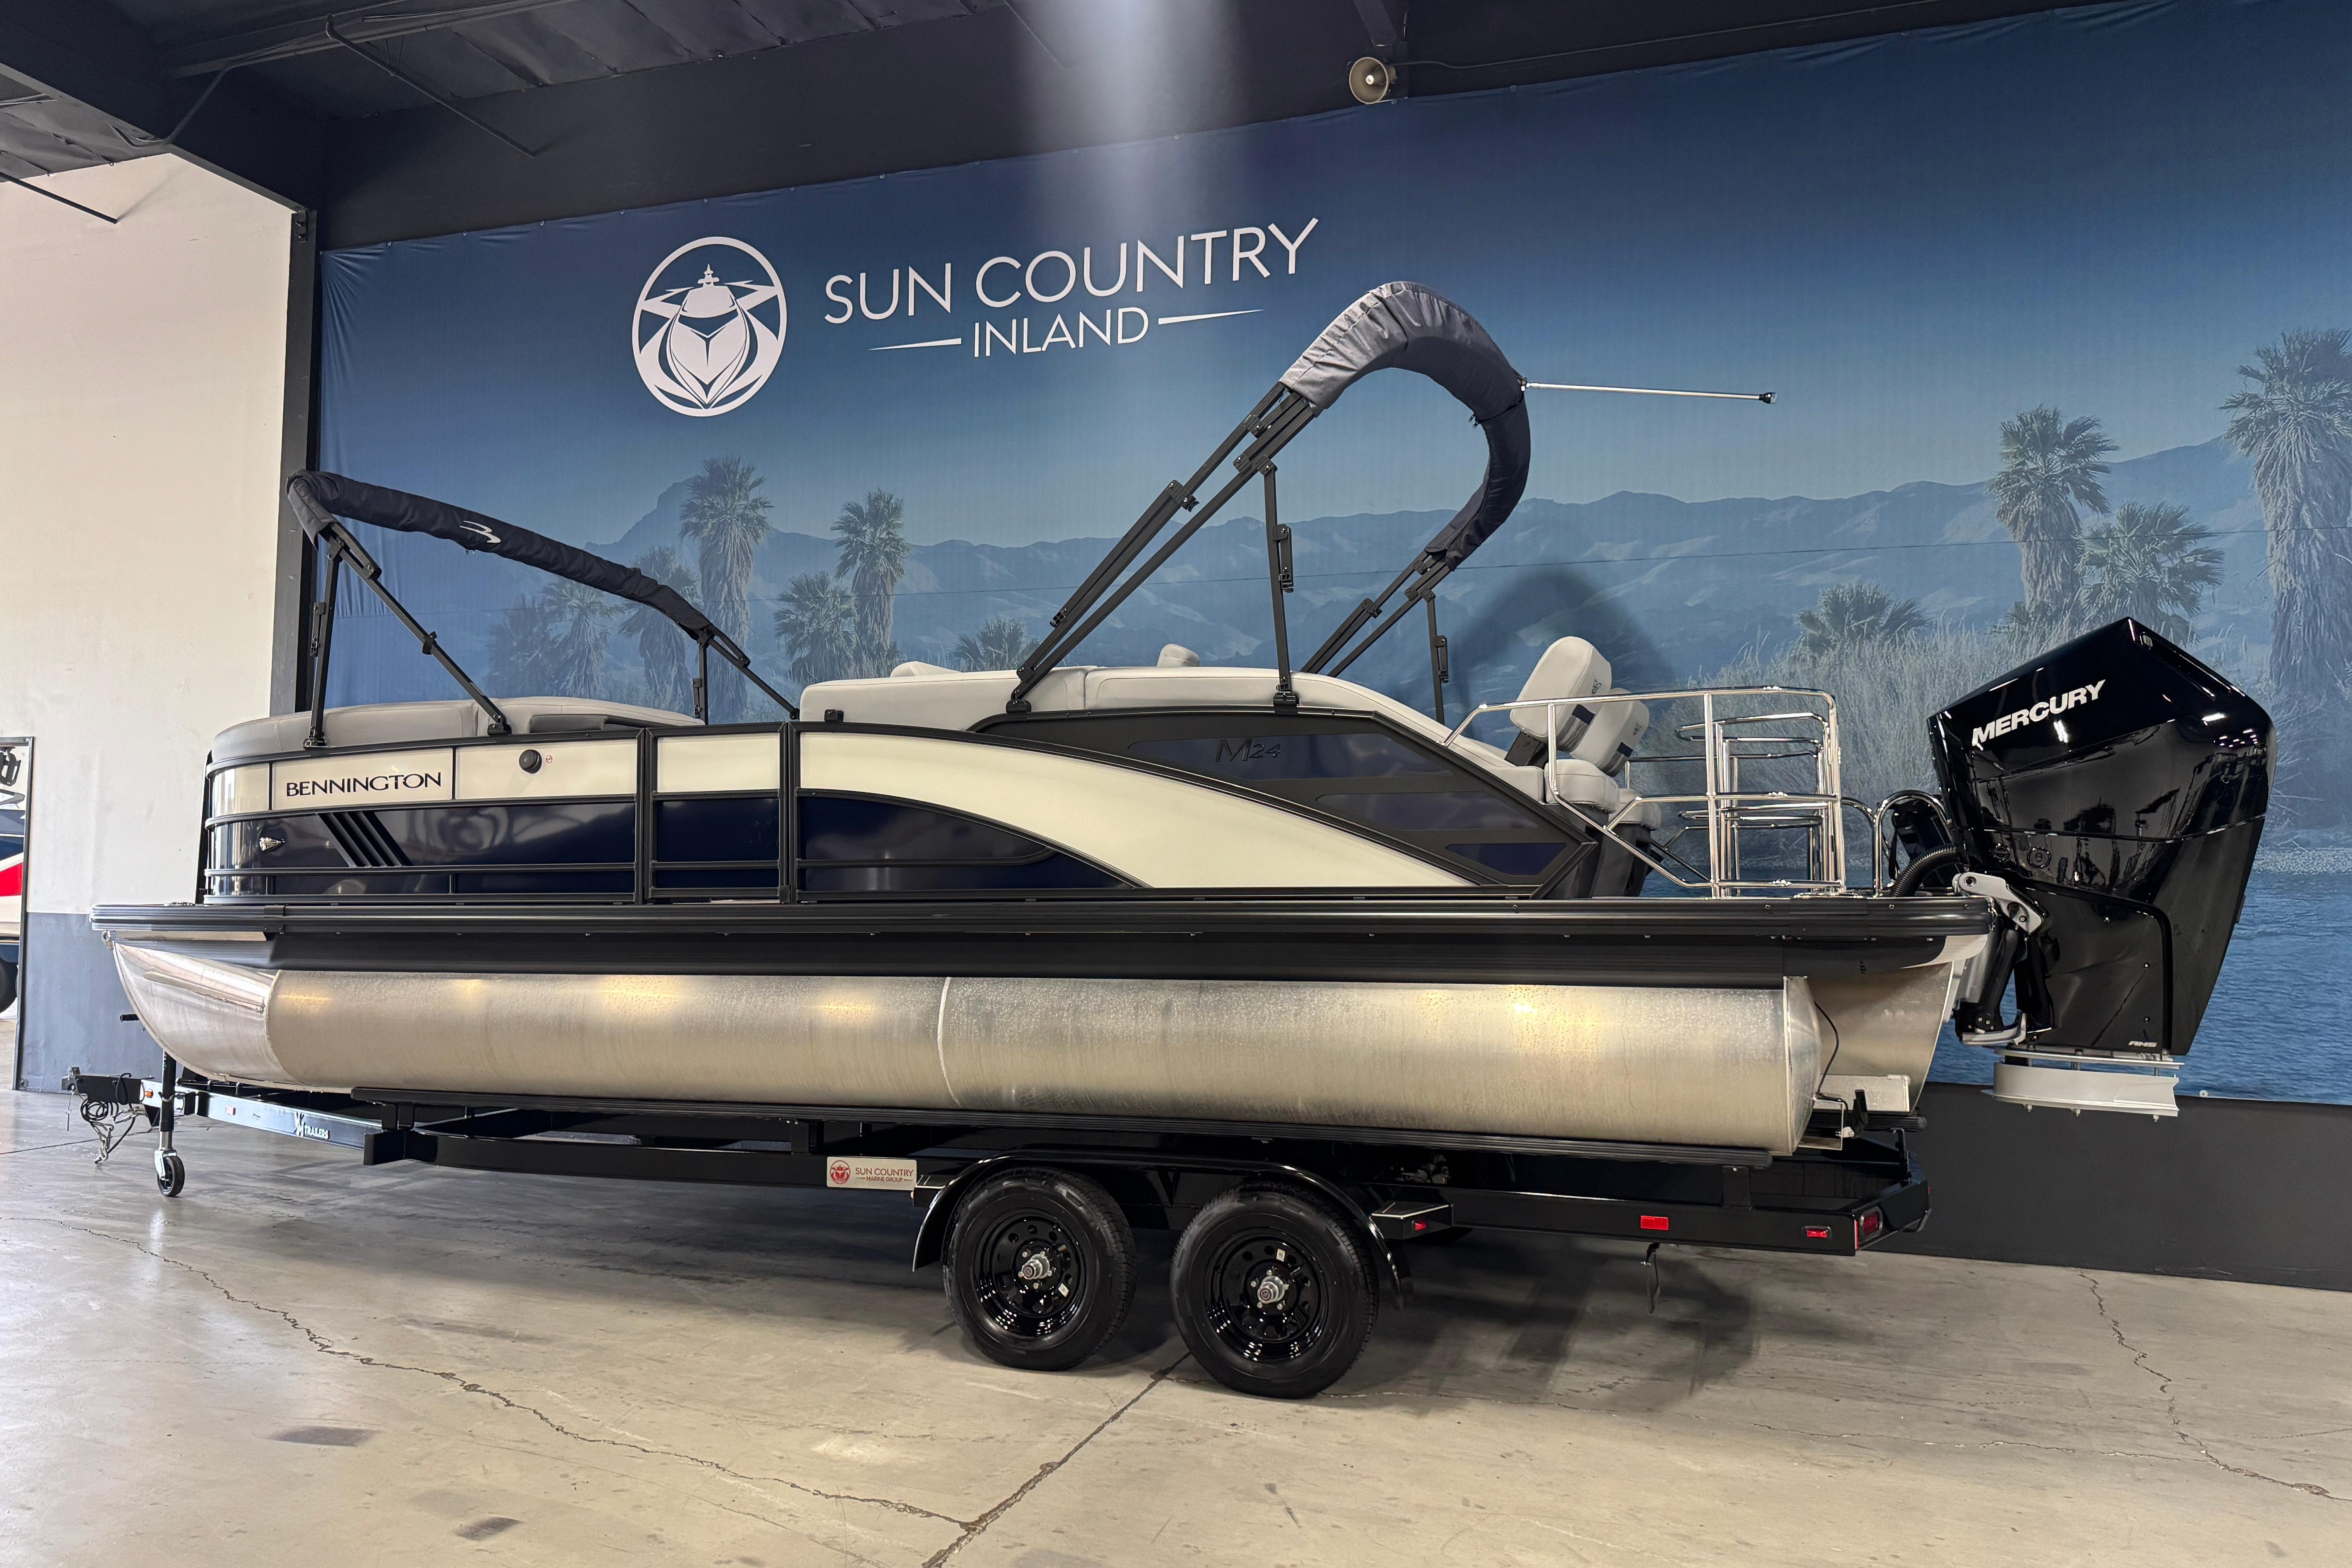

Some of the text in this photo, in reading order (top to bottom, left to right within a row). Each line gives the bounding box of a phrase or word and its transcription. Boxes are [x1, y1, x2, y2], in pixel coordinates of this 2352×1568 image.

[824, 217, 1319, 324] SUN COUNTRY
[974, 306, 1149, 357] INLAND
[1972, 679, 2106, 747] MERCURY
[1215, 738, 1281, 762] M24
[286, 772, 441, 797] BENNINGTON
[304, 1125, 329, 1140] TRAILERS
[855, 1167, 914, 1177] SUN COUNTRY
